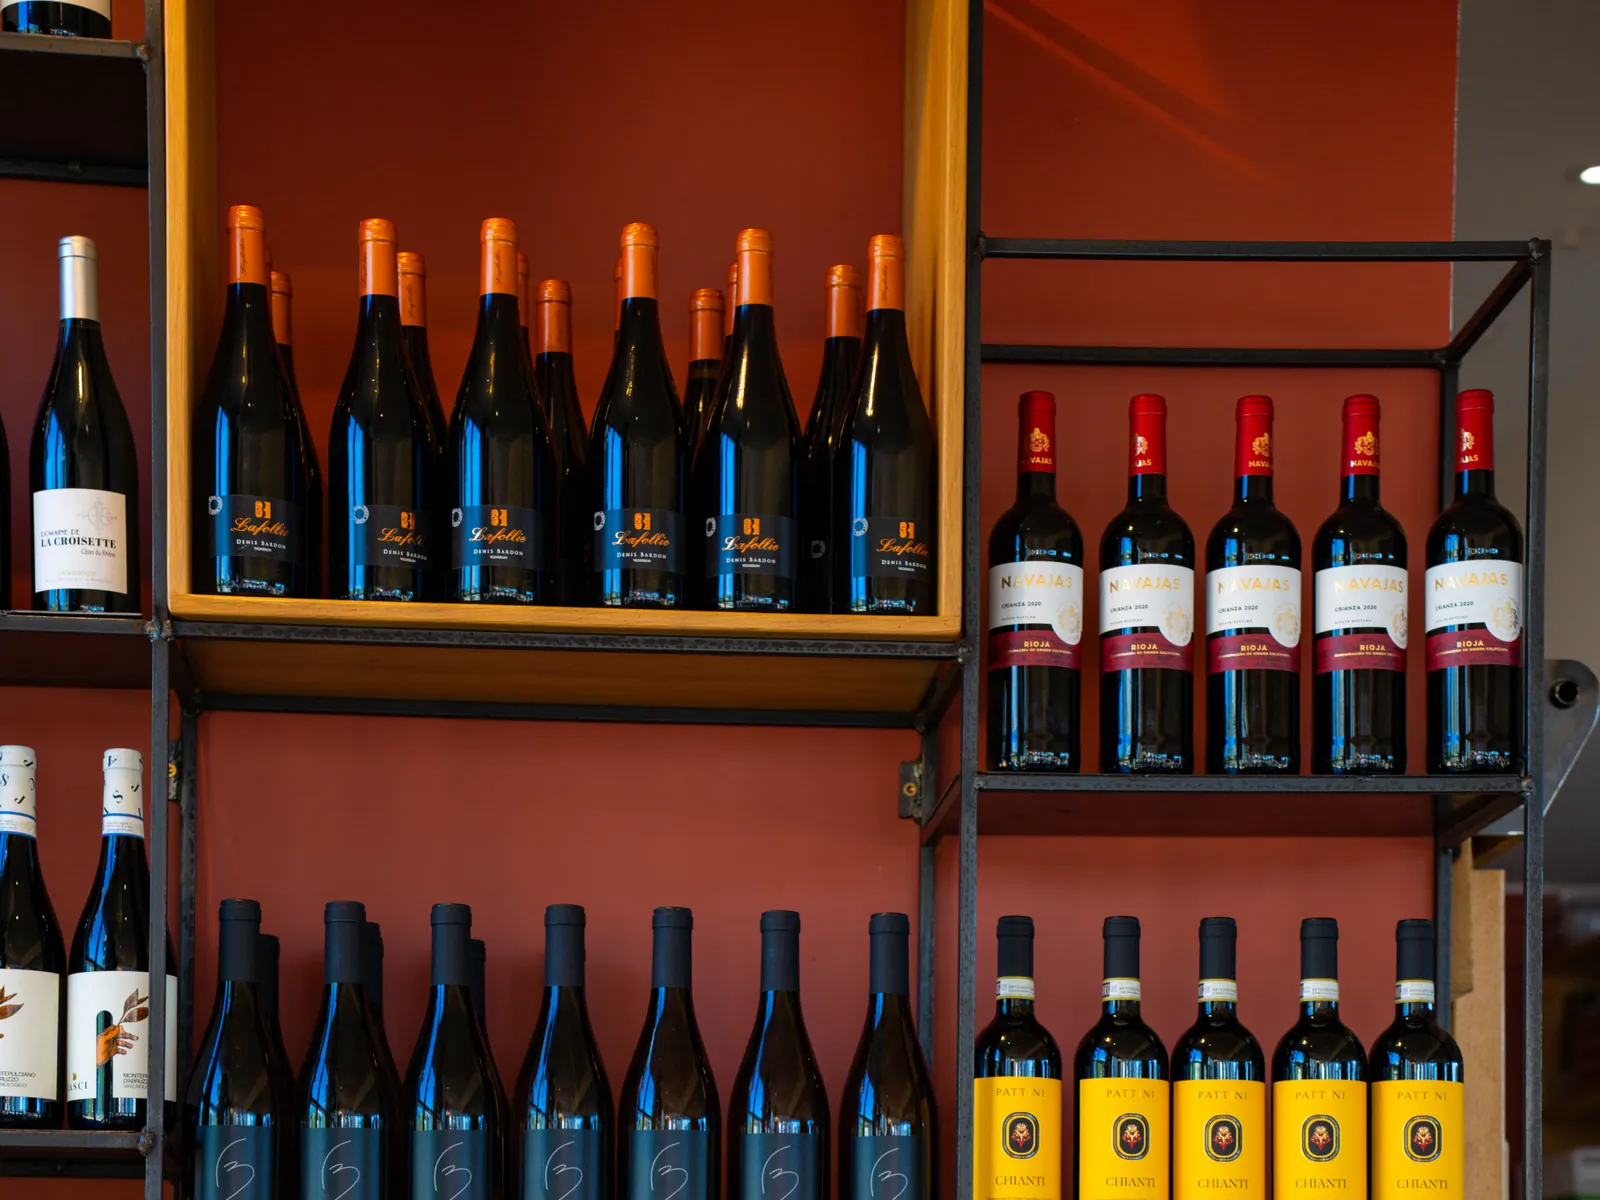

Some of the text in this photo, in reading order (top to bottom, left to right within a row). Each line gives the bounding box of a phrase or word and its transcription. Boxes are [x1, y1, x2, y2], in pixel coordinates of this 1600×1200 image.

[1350, 460, 1373, 468] NAVA
[41, 536, 117, 549] LA CROISETTE
[1001, 574, 1072, 589] NAVAJAS
[1109, 577, 1181, 594] NAVAJAS
[1218, 577, 1289, 594] NAVAJAS
[1334, 577, 1404, 593] NAVAJAS
[1434, 572, 1508, 591] NAVAJAS
[1110, 605, 1133, 613] CRIANZA
[1435, 603, 1458, 611] CRIANZA
[1456, 640, 1484, 648] RIOJA
[996, 1088, 1045, 1097] PATTNI
[1397, 1091, 1447, 1100] PATTNI
[995, 1175, 1046, 1187] CHIANTI
[1105, 1176, 1156, 1188] CHIANTI
[1197, 1178, 1249, 1189] CHIANTI
[1295, 1178, 1347, 1189] CHIANTI
[1396, 1179, 1448, 1190] CHIANTI
